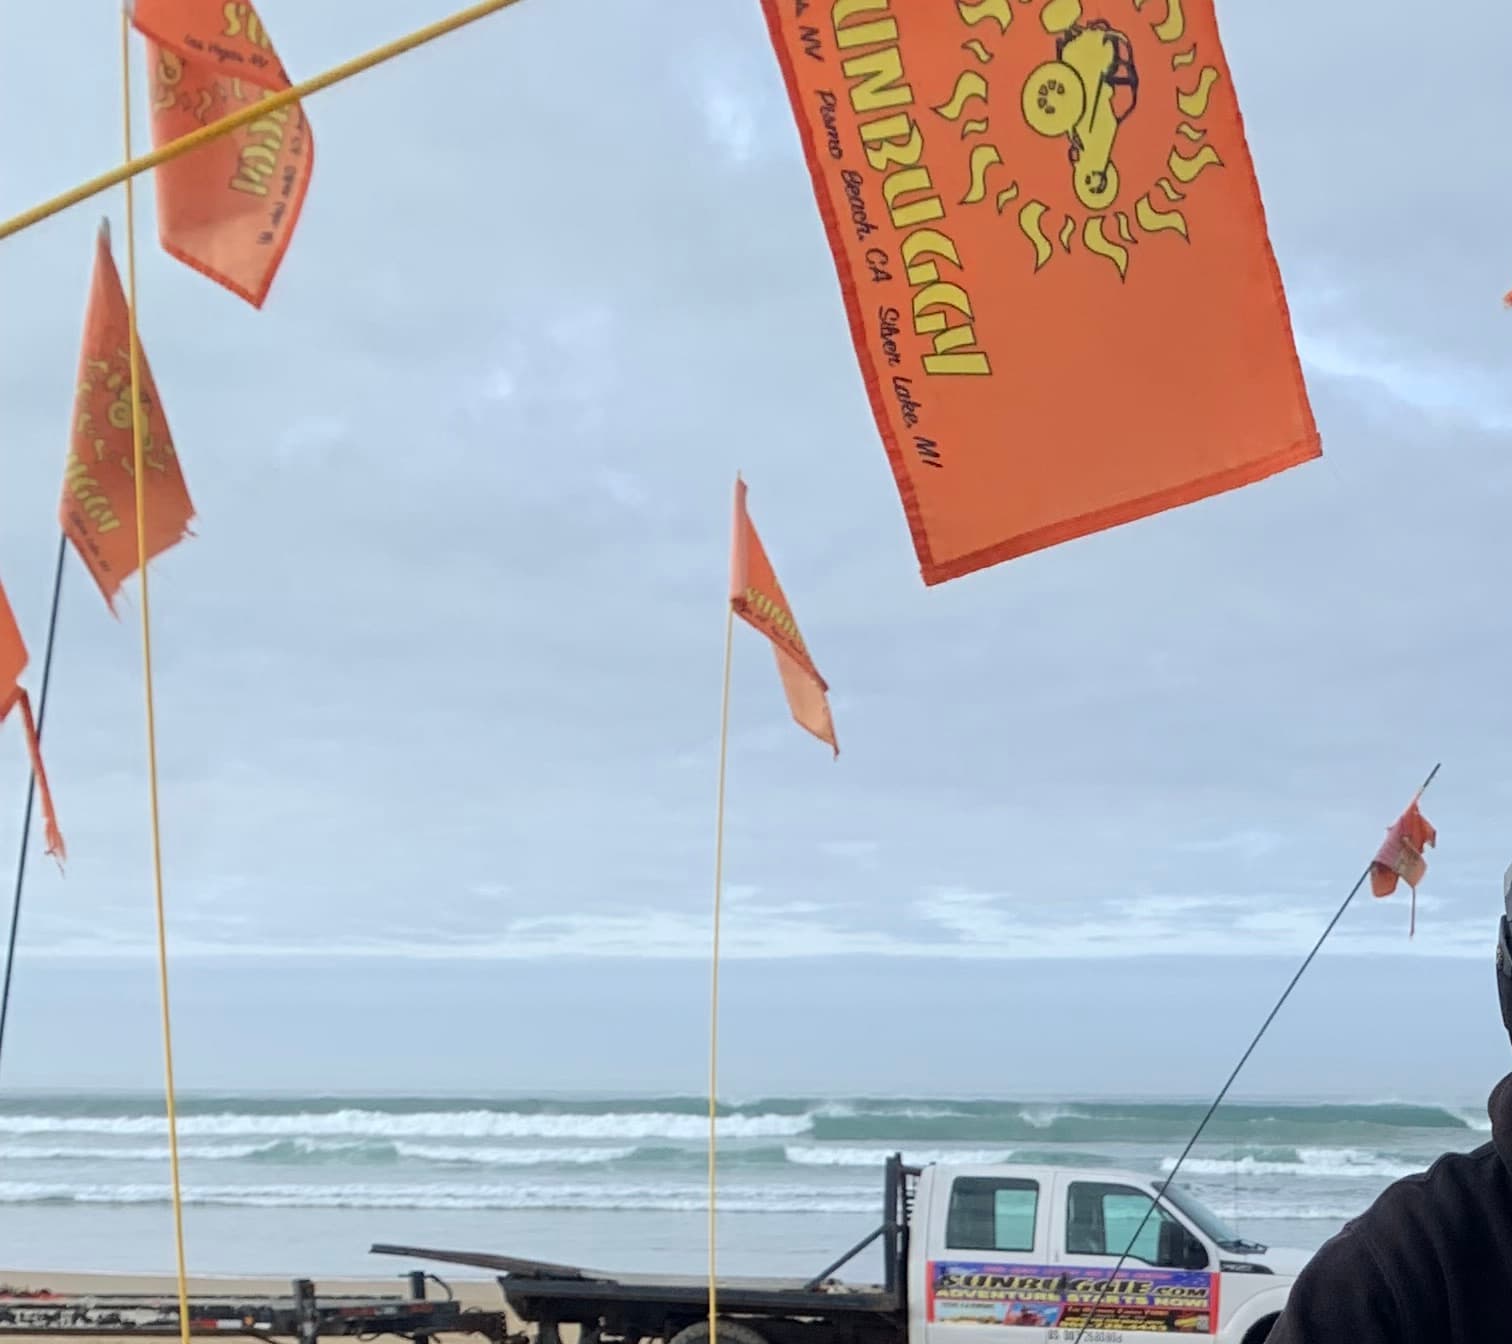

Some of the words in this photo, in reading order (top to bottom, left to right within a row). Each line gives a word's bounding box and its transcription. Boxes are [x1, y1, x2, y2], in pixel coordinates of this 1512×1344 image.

[814, 89, 843, 160] Pismo
[865, 247, 893, 283] CA
[879, 305, 901, 367] Silver
[913, 435, 944, 468] MI
